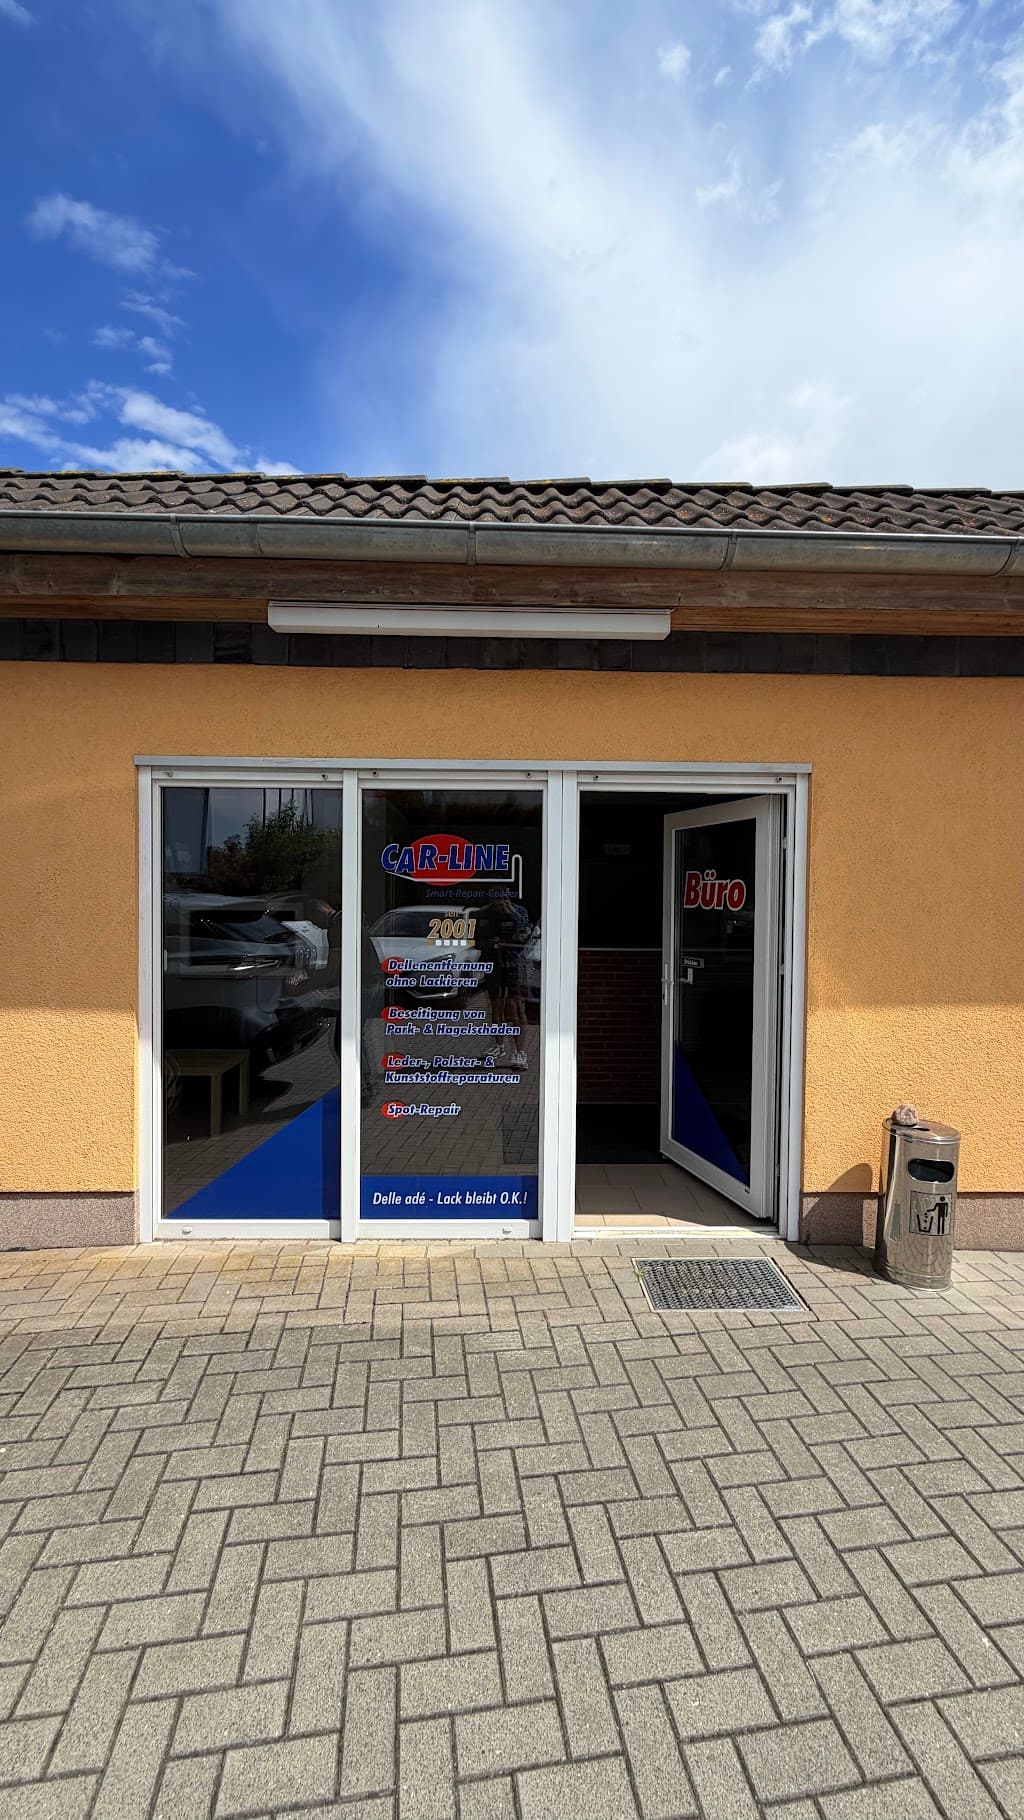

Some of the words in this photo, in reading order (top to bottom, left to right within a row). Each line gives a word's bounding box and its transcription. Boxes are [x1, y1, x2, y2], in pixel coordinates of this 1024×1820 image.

[381, 843, 510, 873] CAR-LINE
[684, 869, 746, 911] Büro
[427, 918, 476, 939] 2001
[388, 959, 494, 974] Dellenentfernung
[386, 974, 417, 987] ohne
[419, 974, 478, 987] Lackieren
[388, 1007, 460, 1020] Beseitigung
[463, 1010, 485, 1019] von
[386, 1024, 420, 1035] Park-
[423, 1024, 433, 1035] &
[436, 1023, 521, 1037] Hagelschäden
[387, 1056, 431, 1069] Leder-,
[433, 1055, 481, 1068] Polster-
[485, 1056, 495, 1068] &
[385, 1071, 520, 1085] Kunststoffreparaturen
[387, 1103, 461, 1117] Spot-Repair
[373, 1192, 401, 1205] Delle
[405, 1192, 425, 1205] adé
[437, 1192, 462, 1205] Lack
[465, 1191, 497, 1205] bleibt
[500, 1191, 528, 1205] O.K.!
